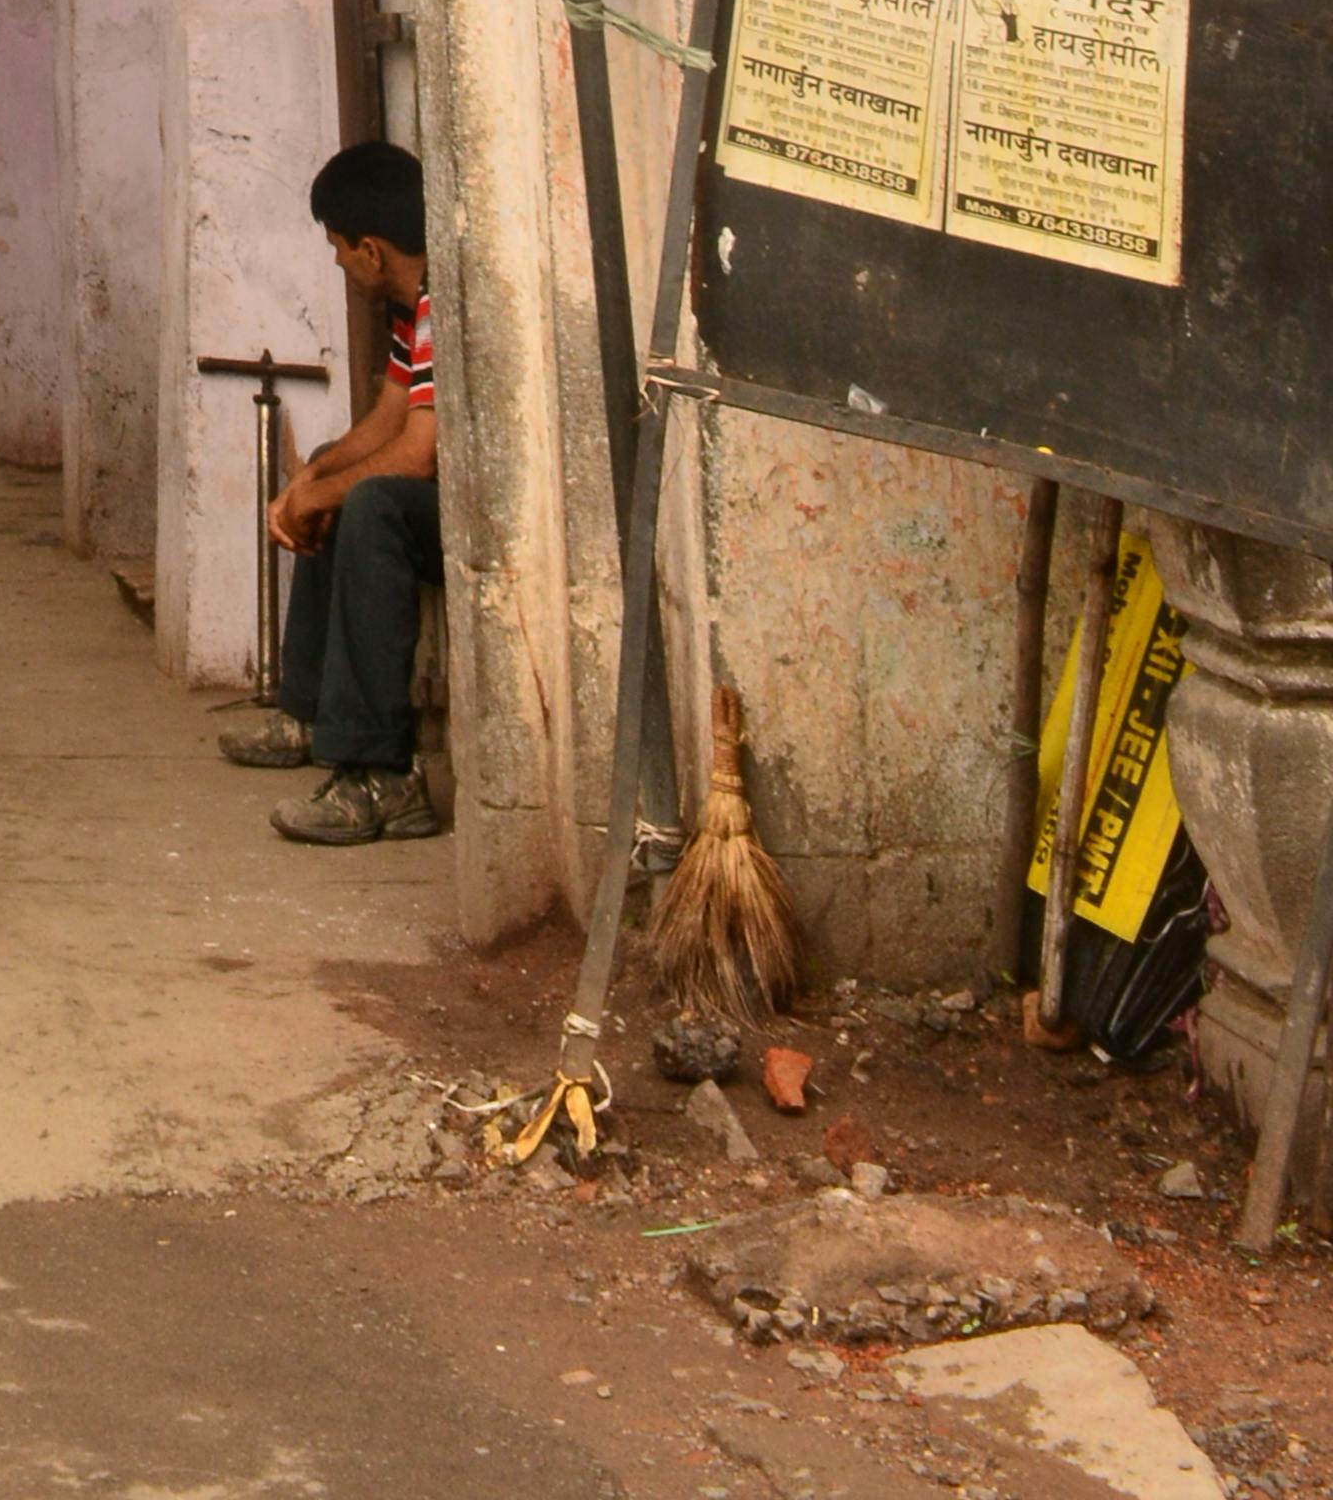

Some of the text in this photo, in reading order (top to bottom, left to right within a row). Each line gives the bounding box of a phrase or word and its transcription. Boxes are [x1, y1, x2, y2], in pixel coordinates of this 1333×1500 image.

[1032, 24, 1161, 74] हायड्रोसील
[741, 55, 824, 98] नागार्जुन
[828, 80, 922, 123] दवाखाना
[785, 143, 908, 192] 9764338558
[963, 120, 1051, 162] नागार्जुन
[1056, 141, 1158, 183] दवाखाना
[1017, 209, 1148, 254] 9764338558
[1144, 626, 1181, 684] XII
[1110, 707, 1155, 786] JEE
[1078, 807, 1125, 896] PMT
